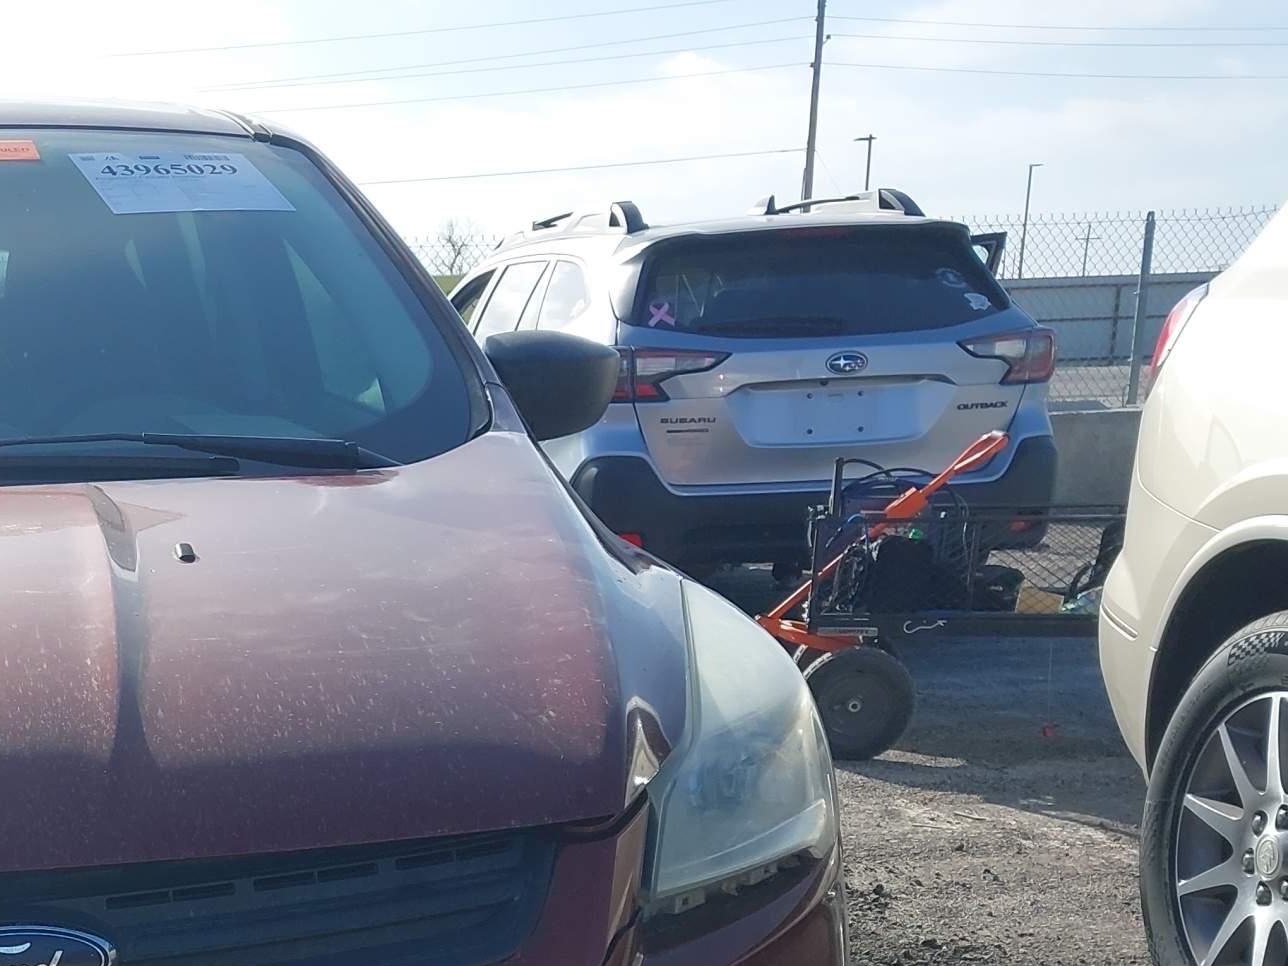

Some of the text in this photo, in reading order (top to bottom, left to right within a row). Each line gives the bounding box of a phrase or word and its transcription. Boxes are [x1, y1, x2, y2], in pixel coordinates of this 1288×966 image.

[100, 163, 238, 176] 43965029
[957, 401, 1009, 411] OUTBACK
[659, 416, 717, 424] SUBARU
